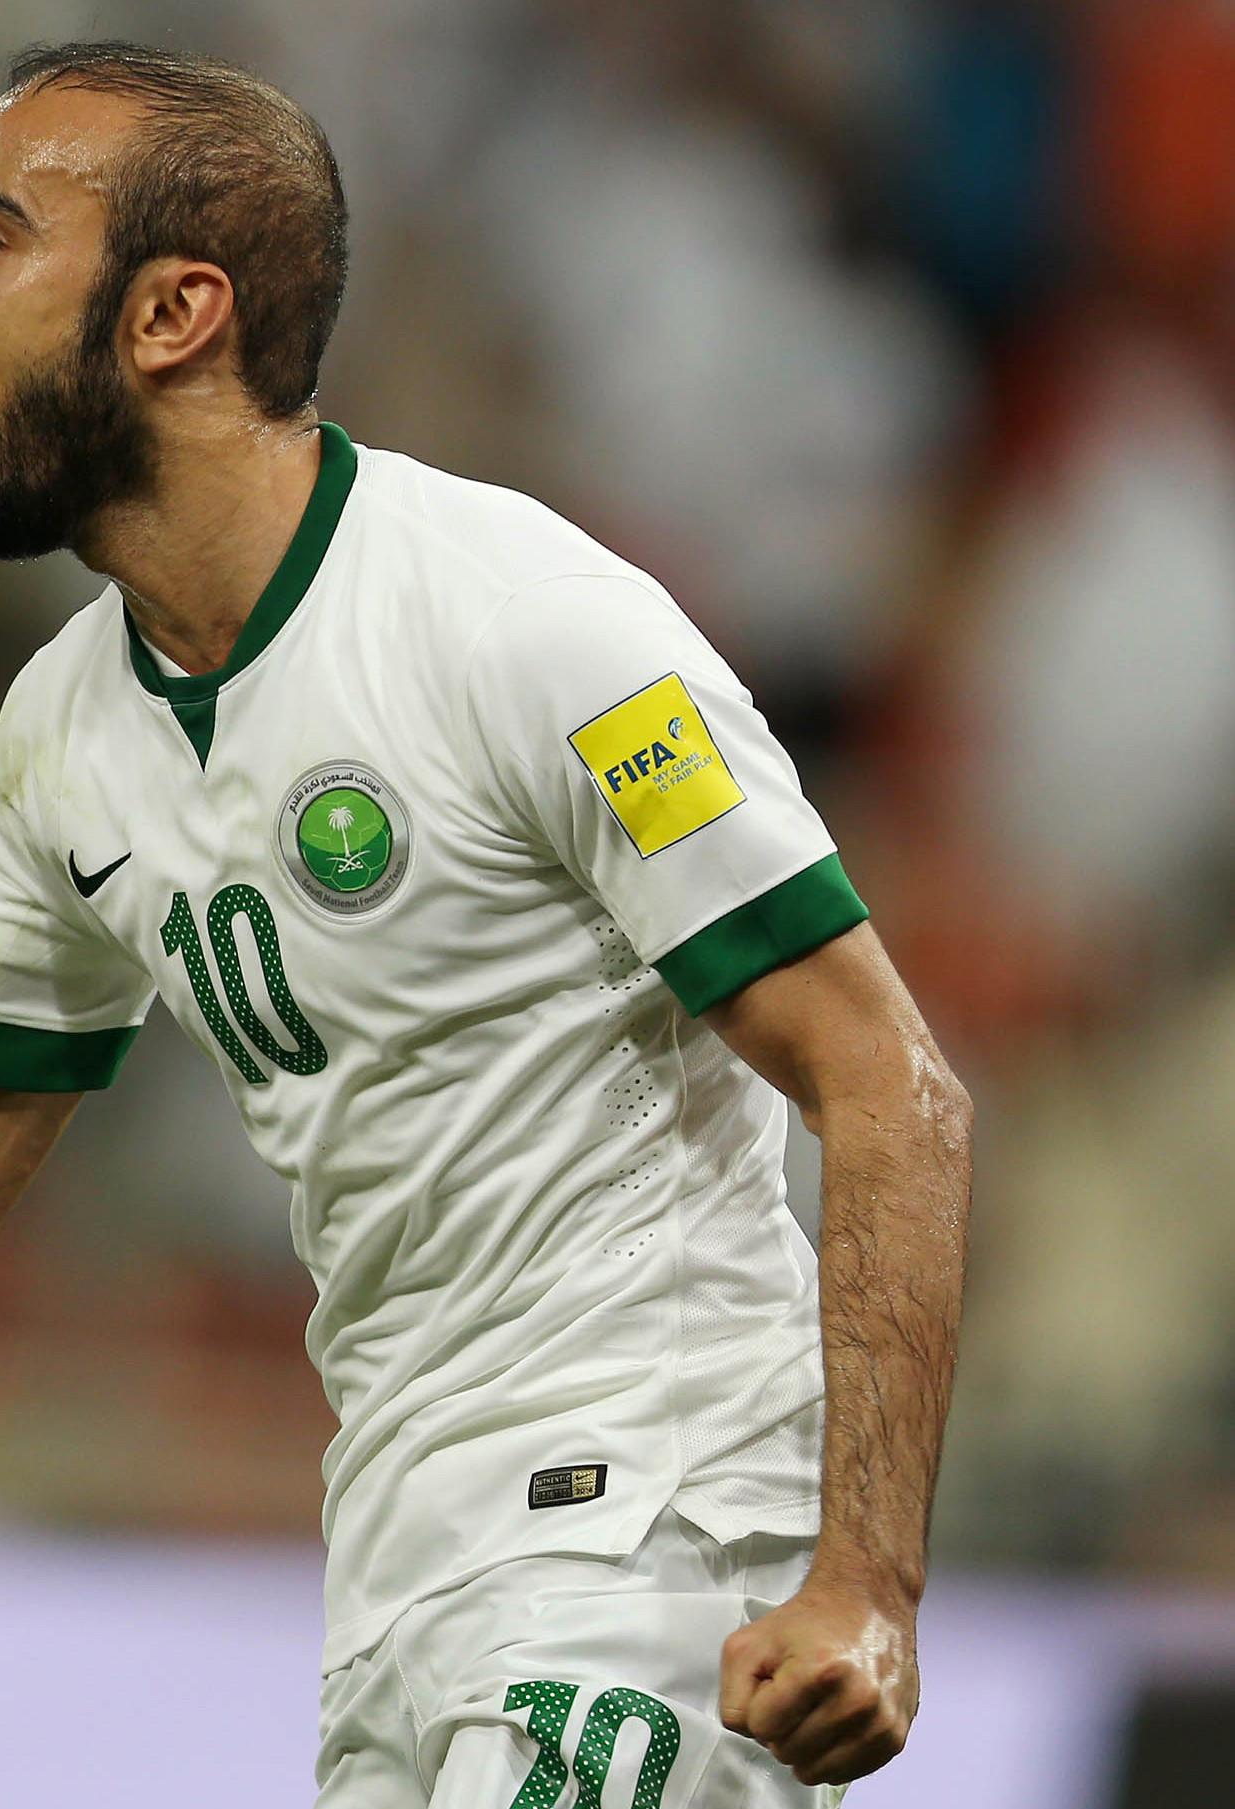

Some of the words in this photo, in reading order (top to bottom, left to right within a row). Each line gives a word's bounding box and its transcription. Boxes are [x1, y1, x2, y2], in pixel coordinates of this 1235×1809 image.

[321, 773, 354, 788] السعودي
[604, 741, 677, 793] FIFA
[652, 769, 669, 784] MY
[671, 752, 700, 772] GAME
[658, 783, 669, 793] IS
[670, 768, 693, 786] FAIR
[694, 755, 713, 770] PLAY
[304, 779, 320, 795] لكرة
[355, 776, 382, 796] المنتخب
[289, 791, 304, 815] القدم
[323, 894, 358, 908] National
[359, 881, 391, 907] Football
[159, 883, 328, 1084] 10
[502, 1680, 681, 1809] 10
